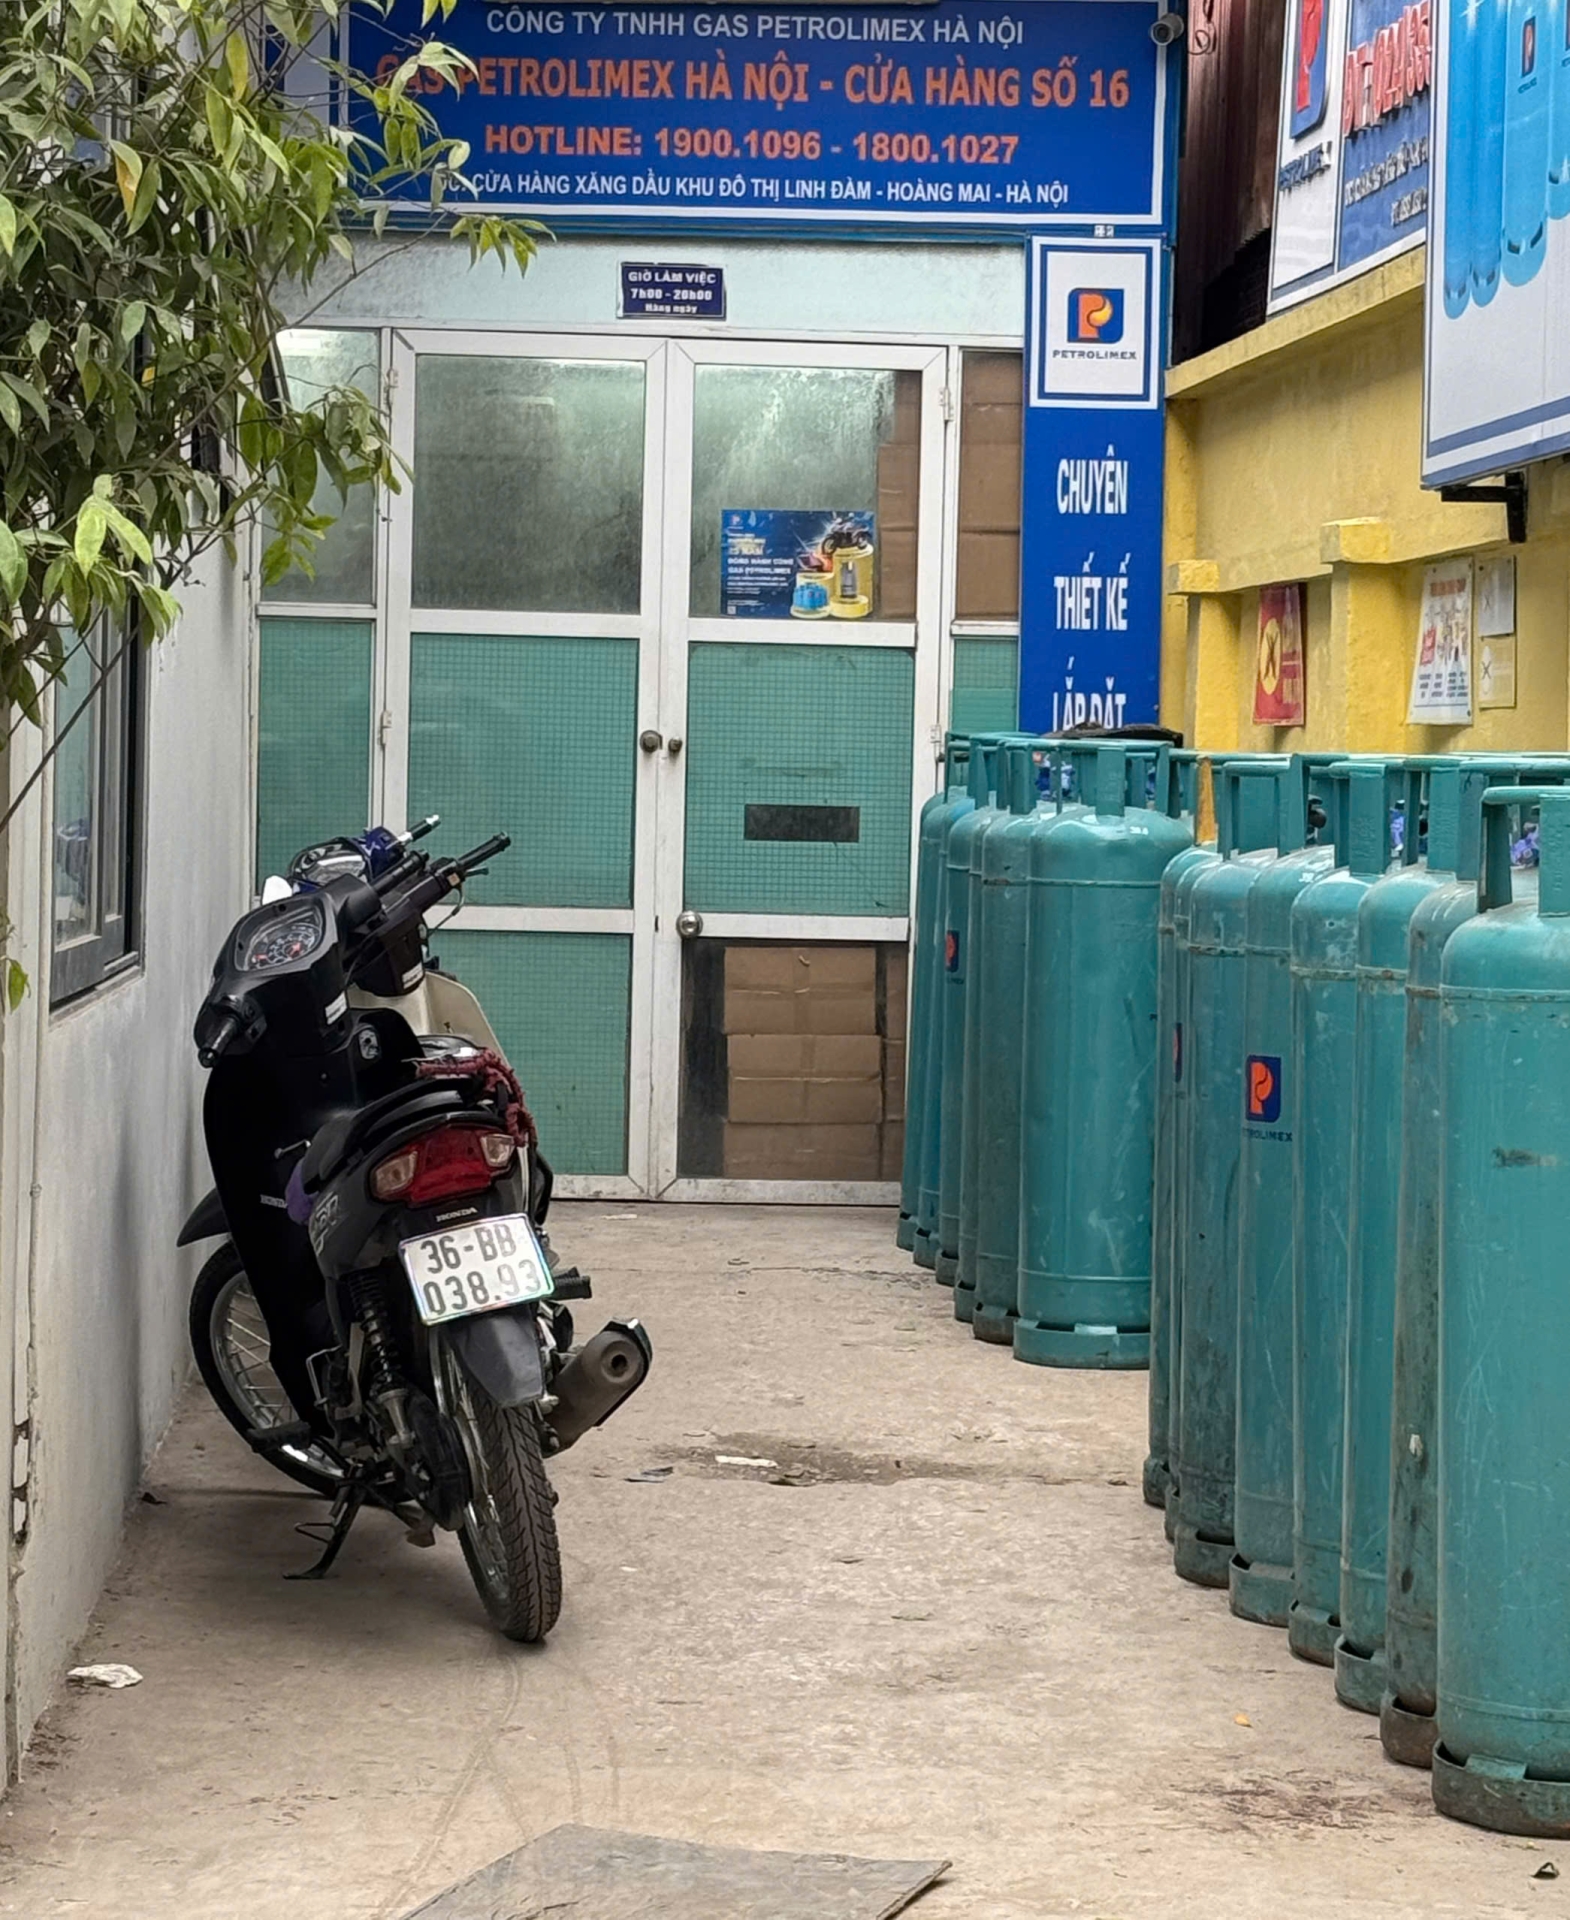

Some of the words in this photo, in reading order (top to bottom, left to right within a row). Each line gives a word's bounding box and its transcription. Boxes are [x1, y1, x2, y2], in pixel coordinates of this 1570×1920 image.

[487, 6, 564, 35] CÔNG
[572, 12, 606, 35] TY
[613, 12, 684, 36] TNHH
[694, 14, 748, 38] GAS
[757, 15, 925, 41] PETROLIMEX
[934, 15, 969, 43] HÀ
[978, 15, 1023, 50] NỘI
[457, 57, 674, 98] PETROLIMEX
[686, 49, 732, 100] HÀ
[744, 50, 809, 110] NỘI
[845, 53, 914, 104] CỬA
[925, 55, 1020, 107] HÀNG
[1031, 55, 1077, 108] SỐ
[1089, 69, 1130, 108] 16
[484, 124, 642, 156] HOTLINE:
[655, 128, 820, 161] 1900.1096
[853, 131, 1020, 165] 1800.1027
[472, 168, 512, 193] CỬA
[518, 170, 571, 195] HÀNG
[575, 170, 627, 196] XĂNG
[632, 167, 671, 196] DẦU
[676, 177, 714, 197] KHU
[719, 173, 746, 198] ĐÔ
[751, 178, 779, 202] THỊ
[784, 180, 826, 199] LINH
[831, 176, 871, 201] ĐÀM
[887, 177, 953, 202] HOÀNG
[958, 183, 991, 202] MAI
[1006, 180, 1033, 203] HÀ
[1036, 180, 1069, 208] NỘI
[630, 288, 662, 299] 7h00
[673, 289, 712, 300] 20h00
[685, 271, 716, 286] VIỆC
[1052, 349, 1137, 360] PETROLIMEX
[1056, 443, 1129, 515] CHUYÊN
[1054, 551, 1102, 631] THIẾT
[1105, 552, 1131, 631] KẾ
[436, 1206, 478, 1222] HONDA
[423, 1259, 541, 1316] 038.93
